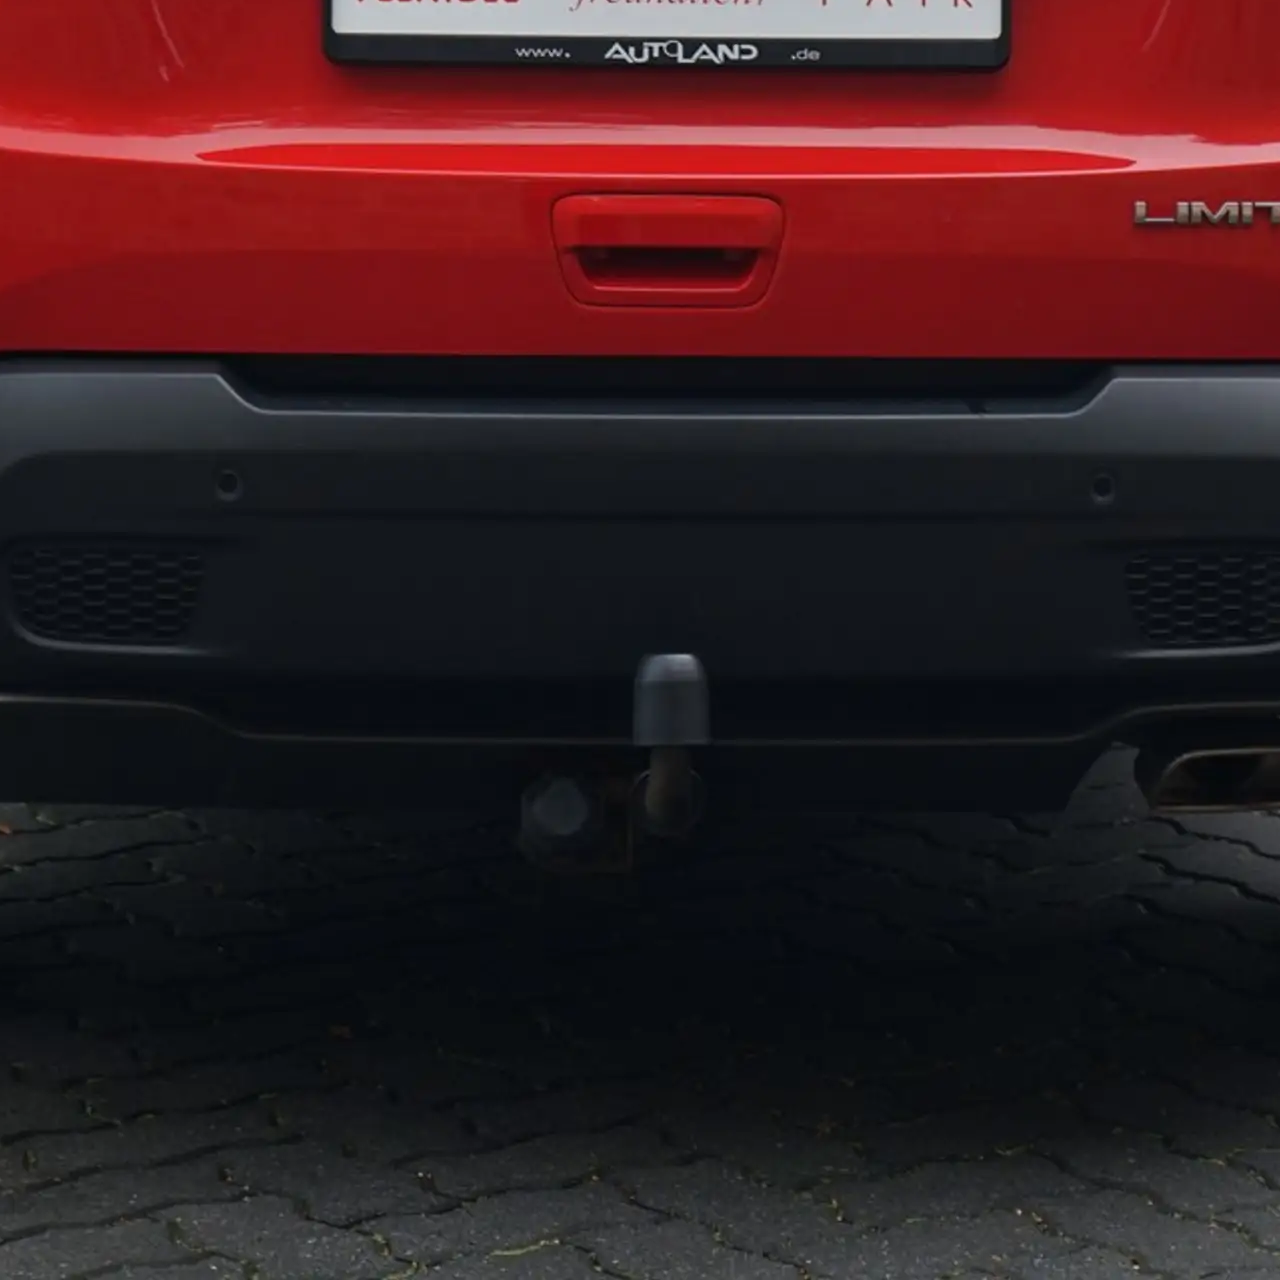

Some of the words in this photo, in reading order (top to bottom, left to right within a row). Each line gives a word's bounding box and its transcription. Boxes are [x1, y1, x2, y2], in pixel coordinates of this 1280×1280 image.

[514, 46, 571, 59] www.
[604, 39, 759, 65] AUTOLAND
[790, 47, 821, 61] .de
